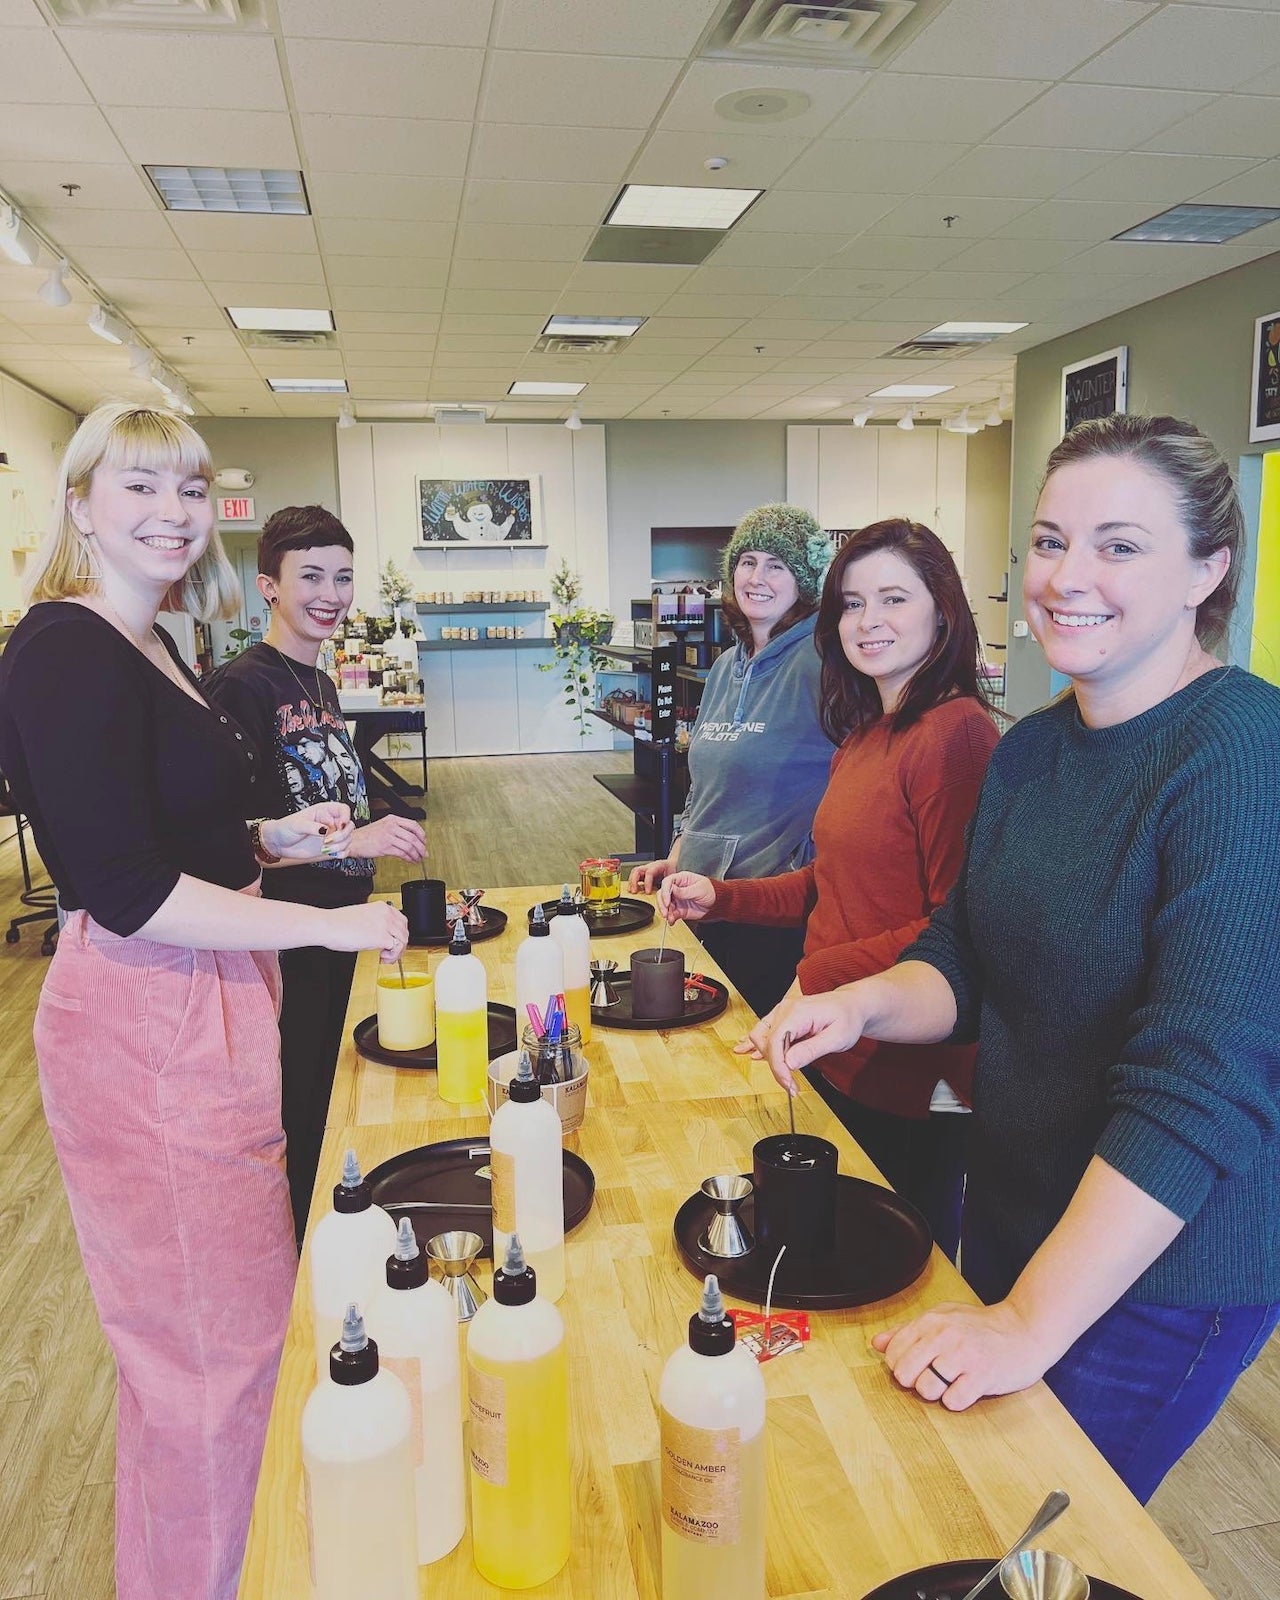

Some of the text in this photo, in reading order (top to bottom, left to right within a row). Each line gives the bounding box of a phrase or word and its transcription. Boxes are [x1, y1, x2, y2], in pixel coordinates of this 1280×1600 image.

[224, 499, 249, 518] EXIT
[660, 662, 671, 672] Exit
[657, 684, 673, 695] Please
[656, 696, 673, 707] Do Not
[658, 709, 671, 719] Enter
[700, 721, 733, 733] WENTY
[695, 1463, 726, 1473] AMBER
[670, 1505, 719, 1529] KALAMAZOO
